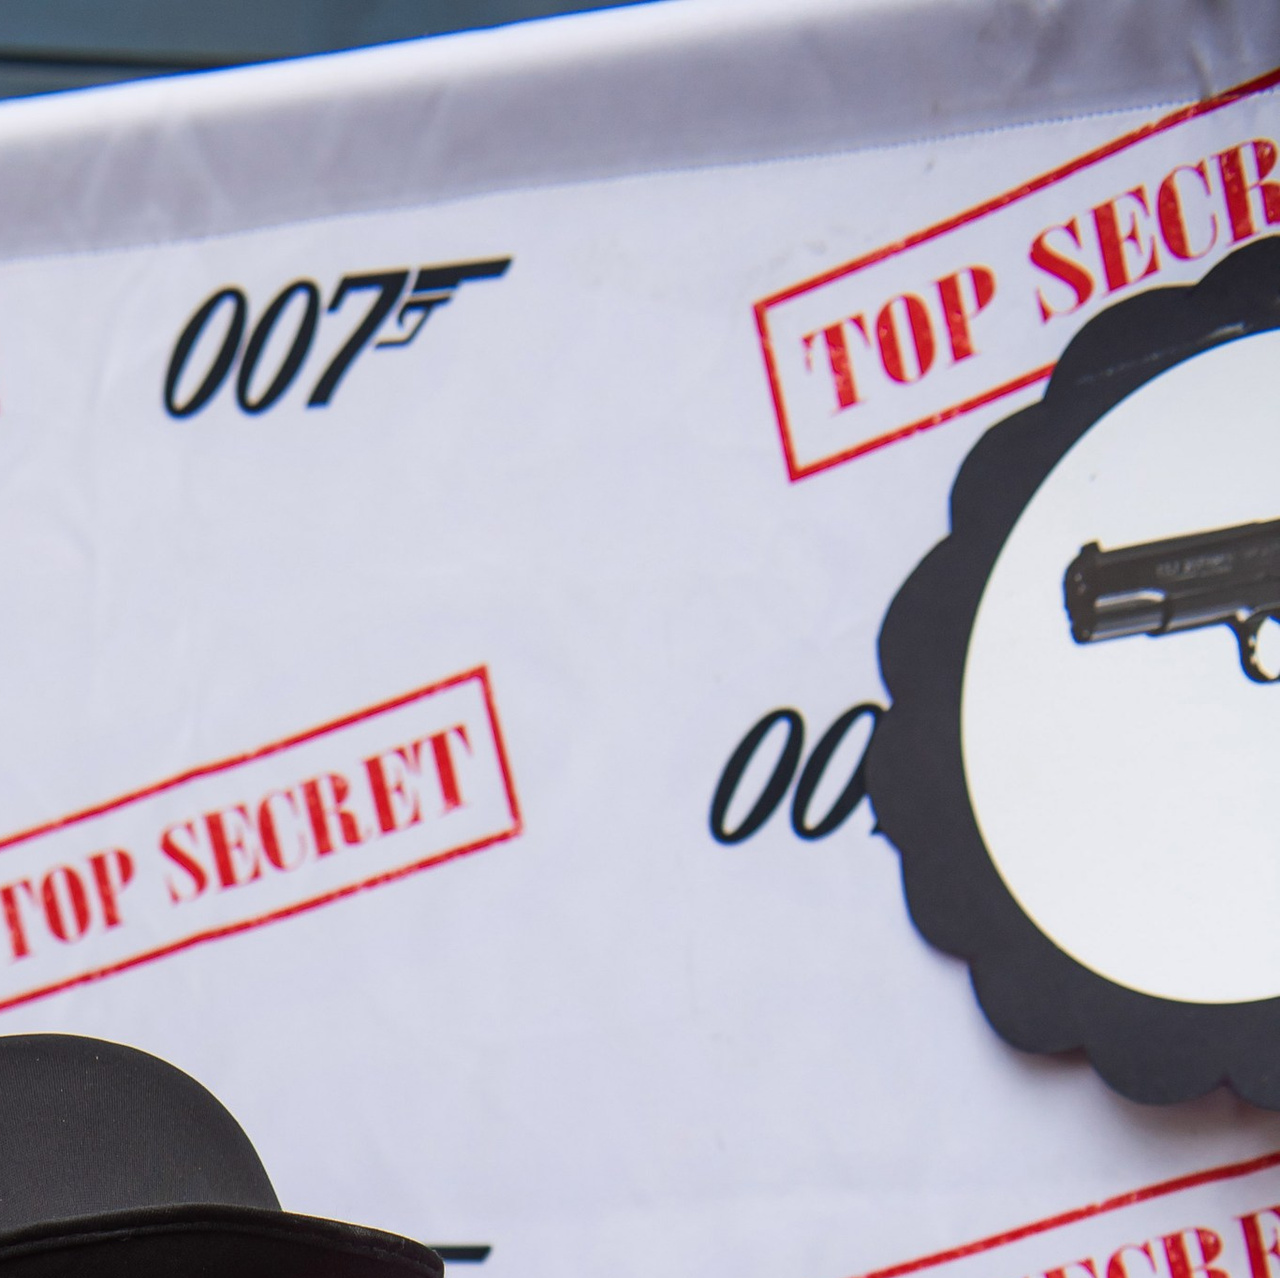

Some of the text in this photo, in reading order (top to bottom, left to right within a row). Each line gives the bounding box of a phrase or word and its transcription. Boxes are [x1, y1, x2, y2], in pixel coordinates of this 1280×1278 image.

[162, 267, 412, 420] 007
[801, 136, 1280, 416] TOP SECR
[158, 723, 474, 907] SECRET
[709, 702, 888, 846] 00
